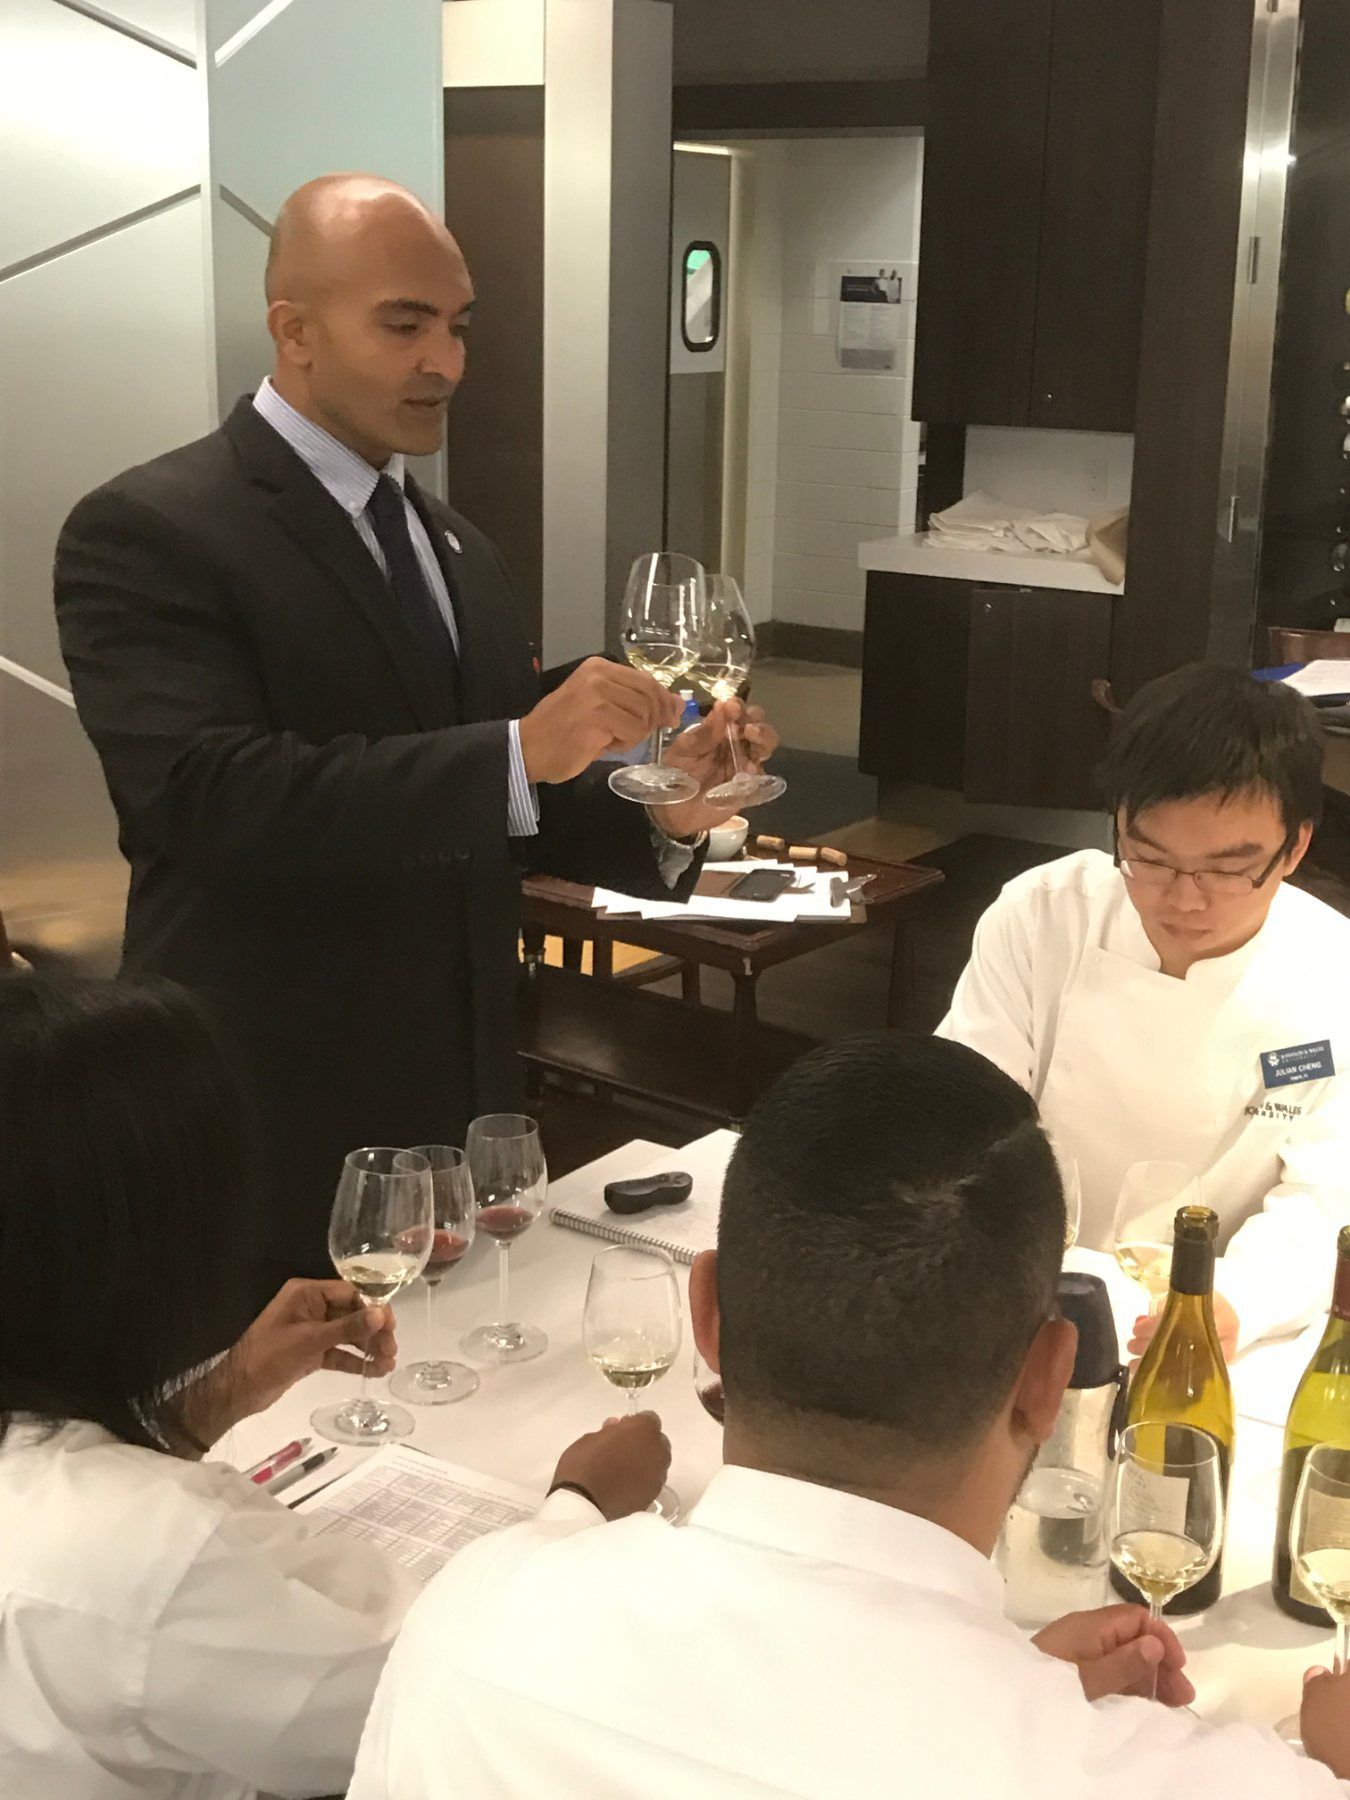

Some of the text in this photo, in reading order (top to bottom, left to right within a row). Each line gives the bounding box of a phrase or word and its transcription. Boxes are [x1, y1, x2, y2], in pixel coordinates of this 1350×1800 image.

[1275, 1066, 1297, 1077] JULIAN
[1298, 1061, 1322, 1072] CHENG
[1274, 1103, 1302, 1115] WALES
